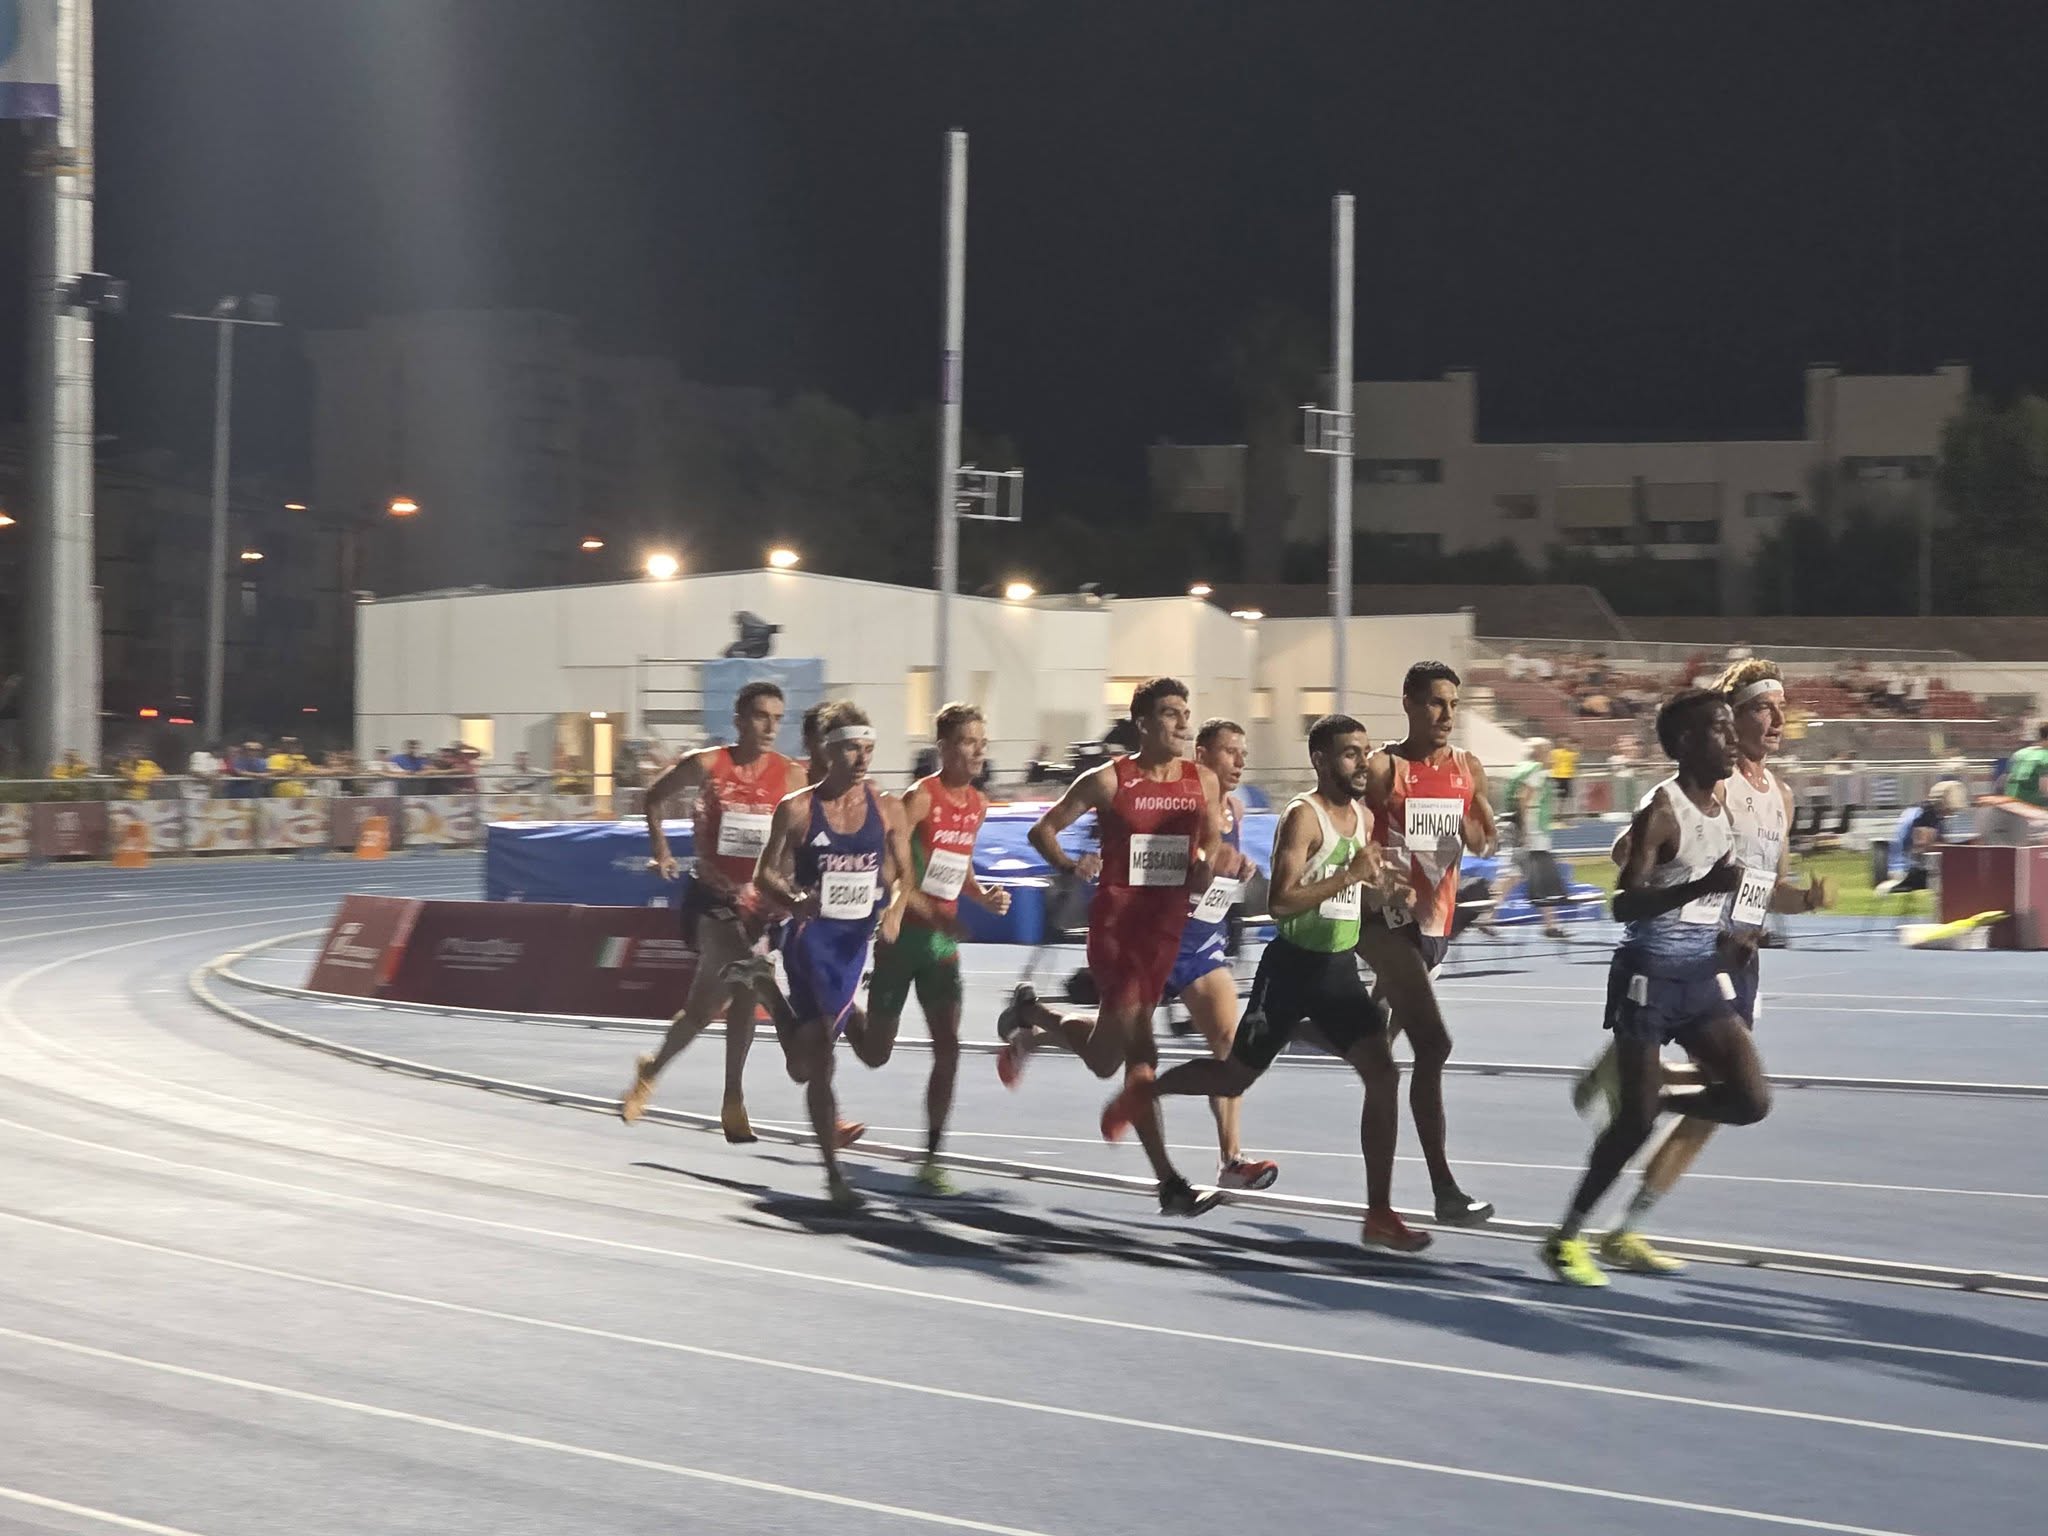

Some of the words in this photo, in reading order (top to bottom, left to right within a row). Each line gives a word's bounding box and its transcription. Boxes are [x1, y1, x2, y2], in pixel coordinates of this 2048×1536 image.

[1135, 797, 1196, 811] MOROCCO
[1758, 828, 1780, 842] ITALIA
[817, 852, 878, 871] FRANCE
